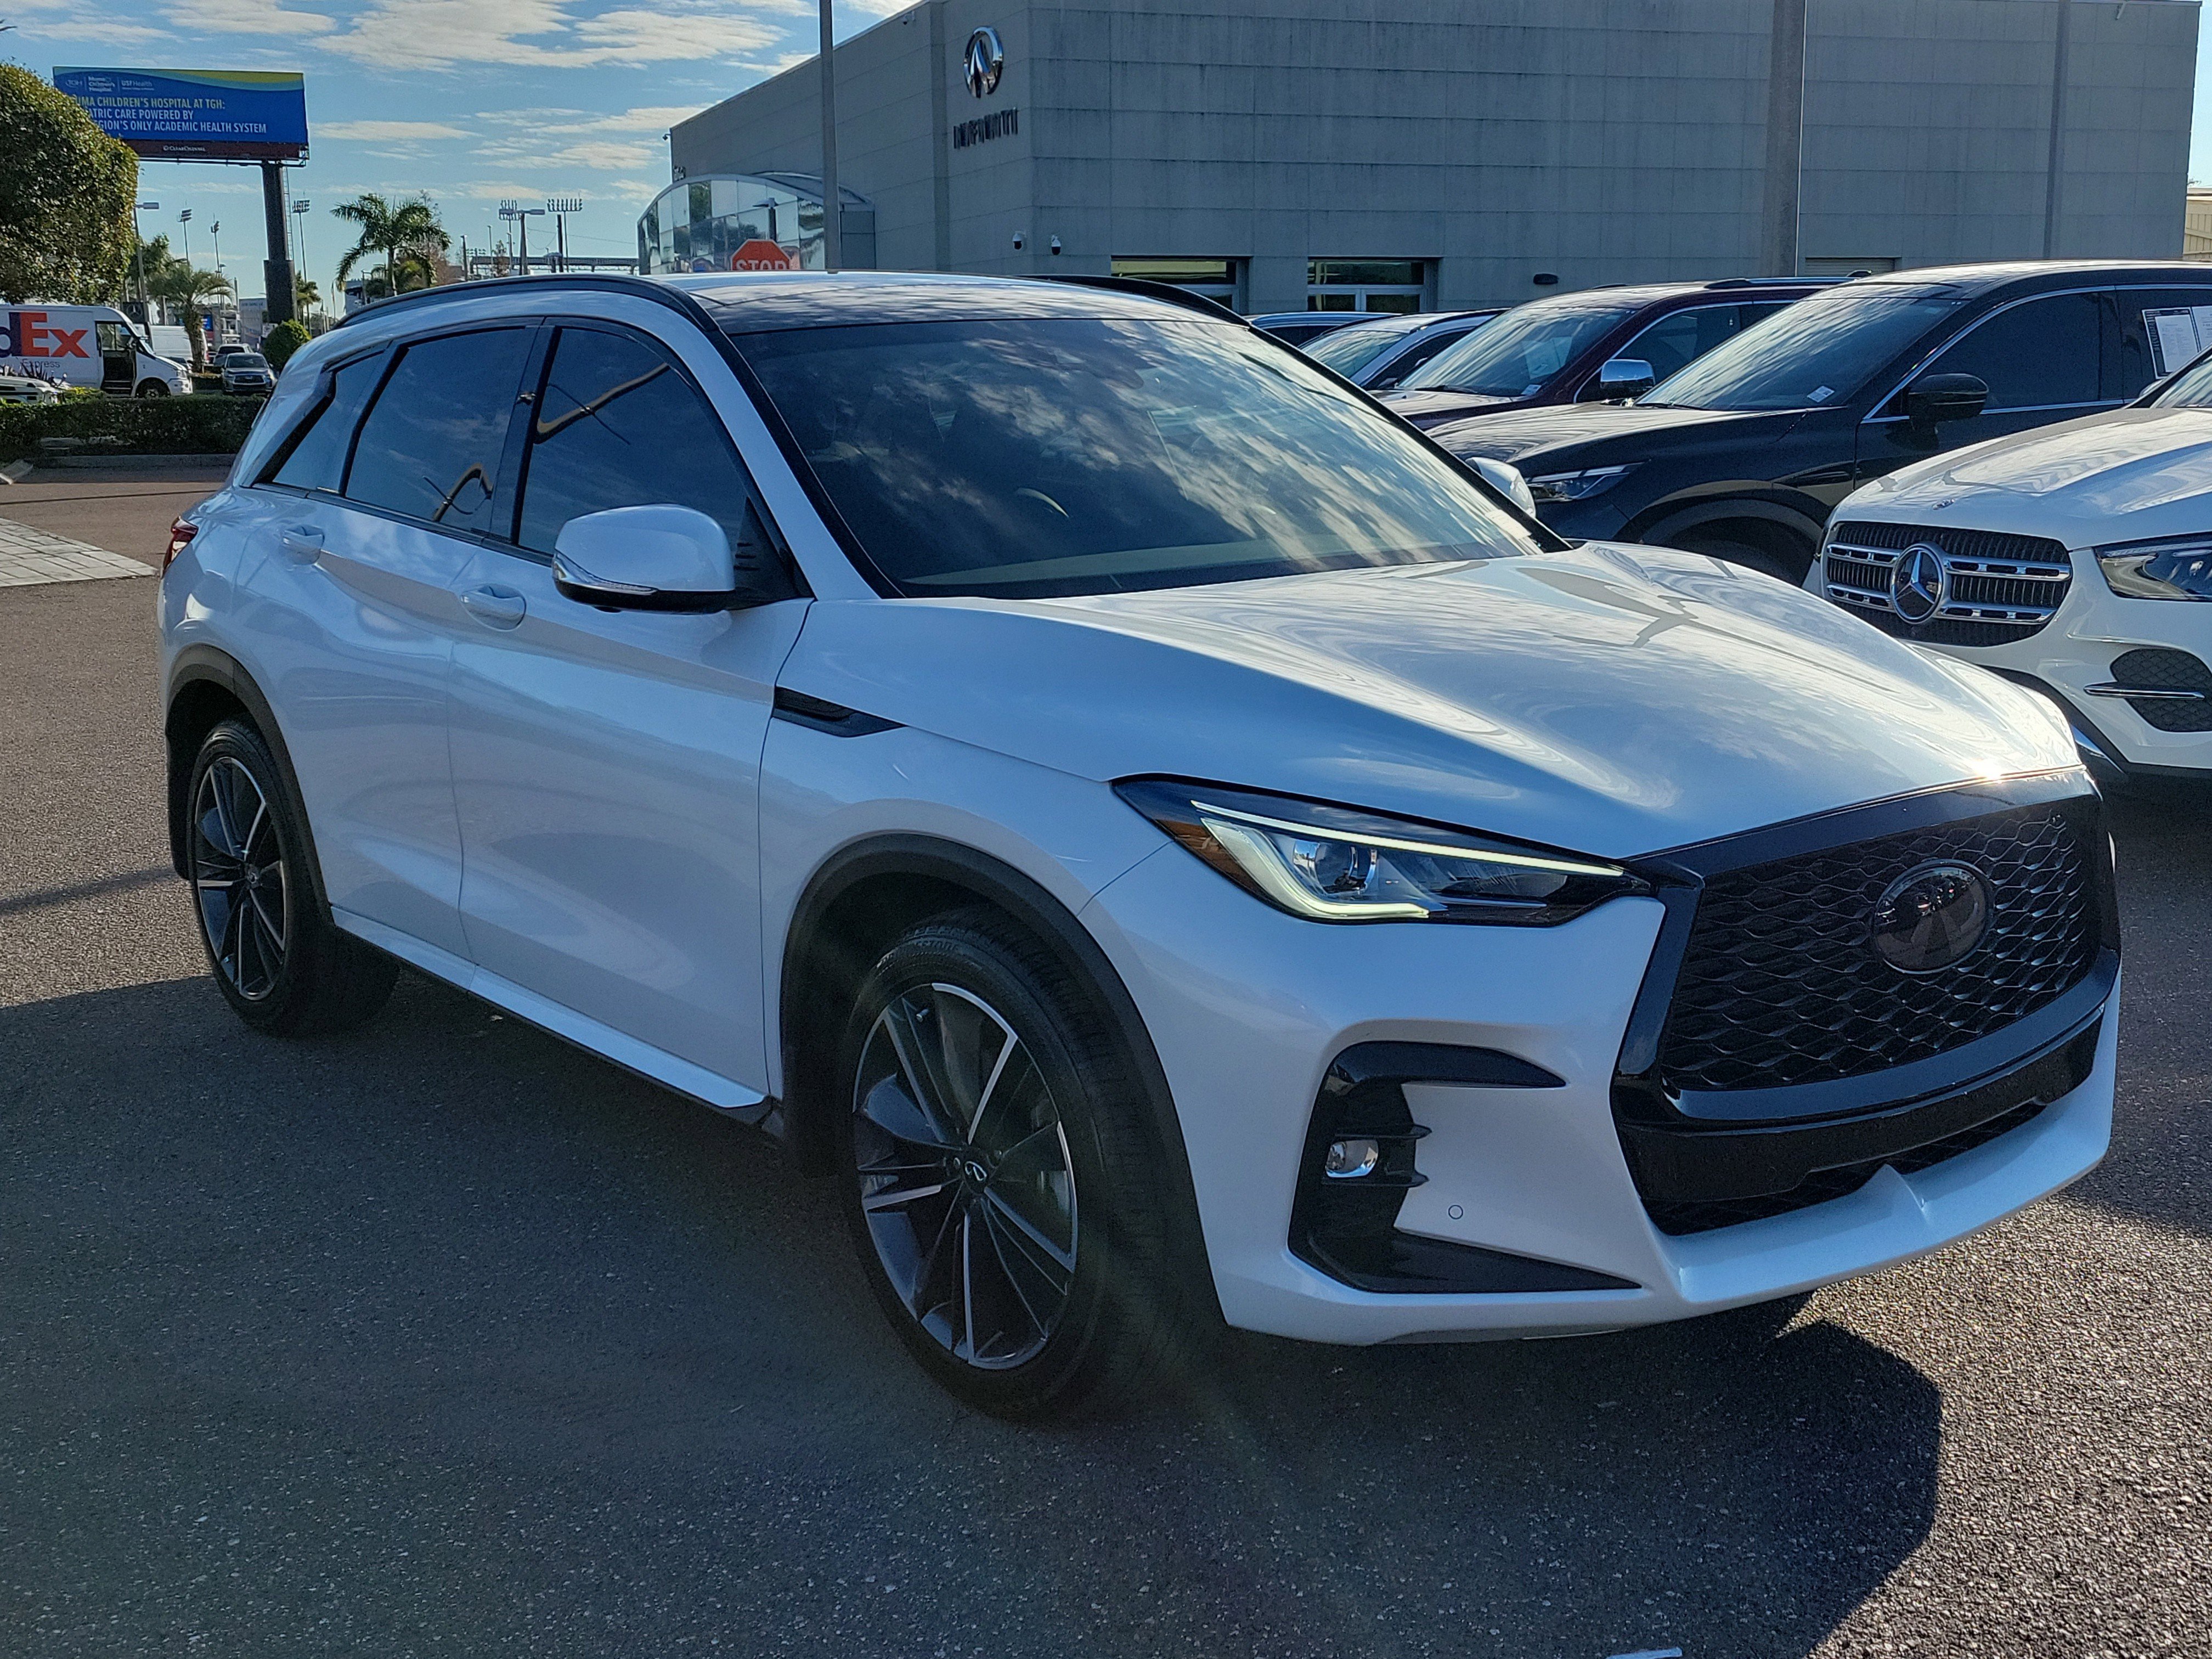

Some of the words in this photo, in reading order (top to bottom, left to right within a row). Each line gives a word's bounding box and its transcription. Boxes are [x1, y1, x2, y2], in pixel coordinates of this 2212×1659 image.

[76, 97, 95, 106] UMA
[97, 97, 149, 108] CHILDREN'S
[151, 98, 191, 109] HOSPITAL
[194, 99, 203, 108] AT
[205, 99, 225, 109] TGH:
[88, 108, 112, 118] ATRIC
[115, 109, 137, 119] CARE
[139, 110, 180, 120] POWERED
[183, 110, 193, 120] BY
[95, 120, 128, 131] GION'S
[131, 121, 152, 131] ONLY
[154, 121, 198, 132] ACADEMIC
[200, 122, 232, 132] HEALTH
[234, 123, 266, 133] SYSTEM
